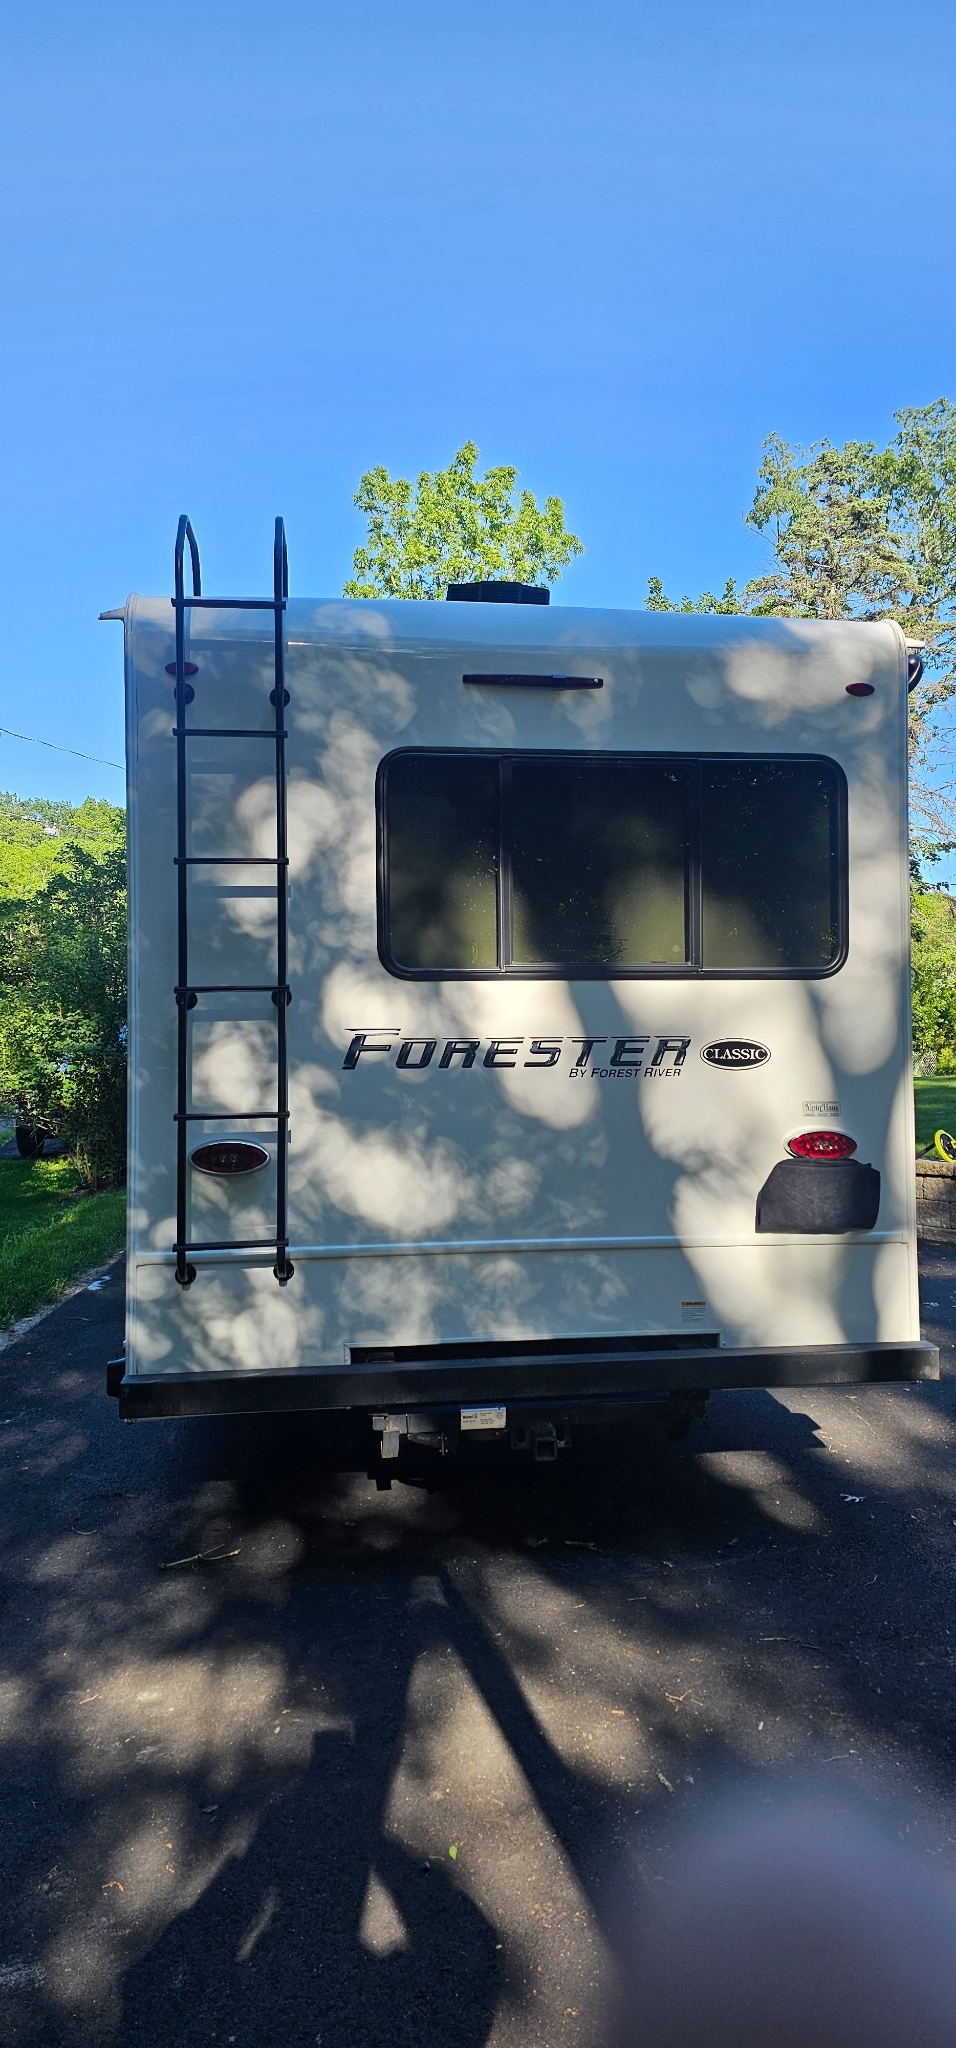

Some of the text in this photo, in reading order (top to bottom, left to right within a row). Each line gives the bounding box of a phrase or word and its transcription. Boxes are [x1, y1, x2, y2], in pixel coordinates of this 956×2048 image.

[341, 1029, 691, 1070] FORESTER
[703, 1048, 766, 1060] CLASSIC
[569, 1067, 682, 1078] BY FOREST RIVER
